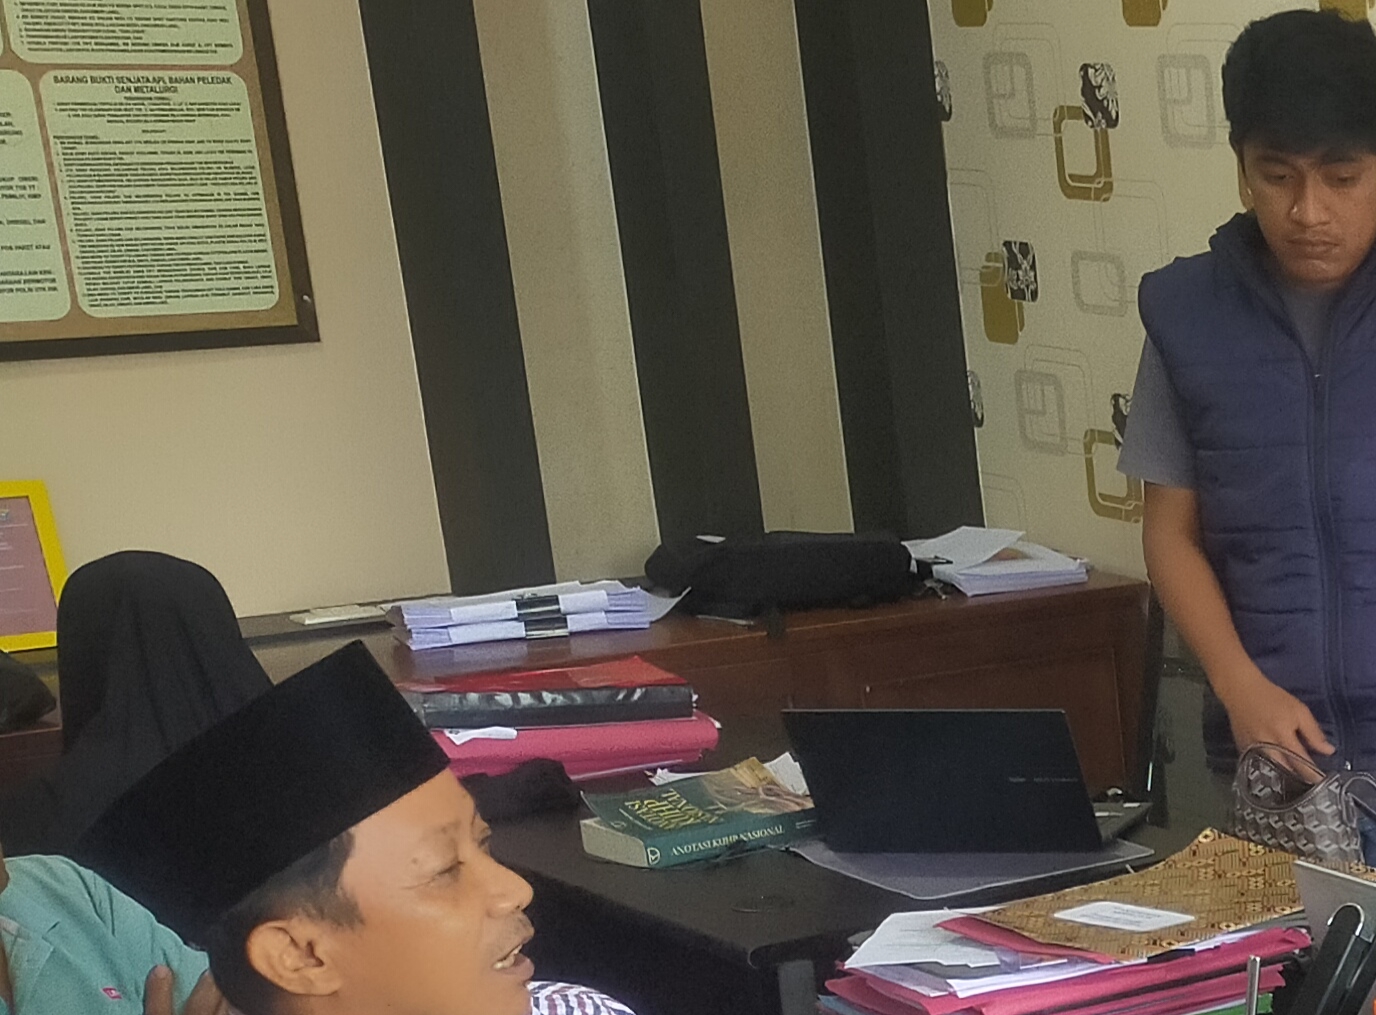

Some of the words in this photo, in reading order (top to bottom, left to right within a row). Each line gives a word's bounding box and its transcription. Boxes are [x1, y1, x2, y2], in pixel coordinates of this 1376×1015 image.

[53, 75, 88, 84] BARANG
[90, 75, 114, 84] BUKTI
[115, 76, 151, 84] SENJATA
[168, 76, 196, 84] BAHAN
[197, 76, 232, 85] PELEDAK
[114, 85, 132, 94] DAN
[133, 85, 178, 94] METALURGI
[671, 840, 711, 856] ANOTASI
[712, 834, 739, 848] KUHP
[739, 825, 784, 841] NASIONAL
